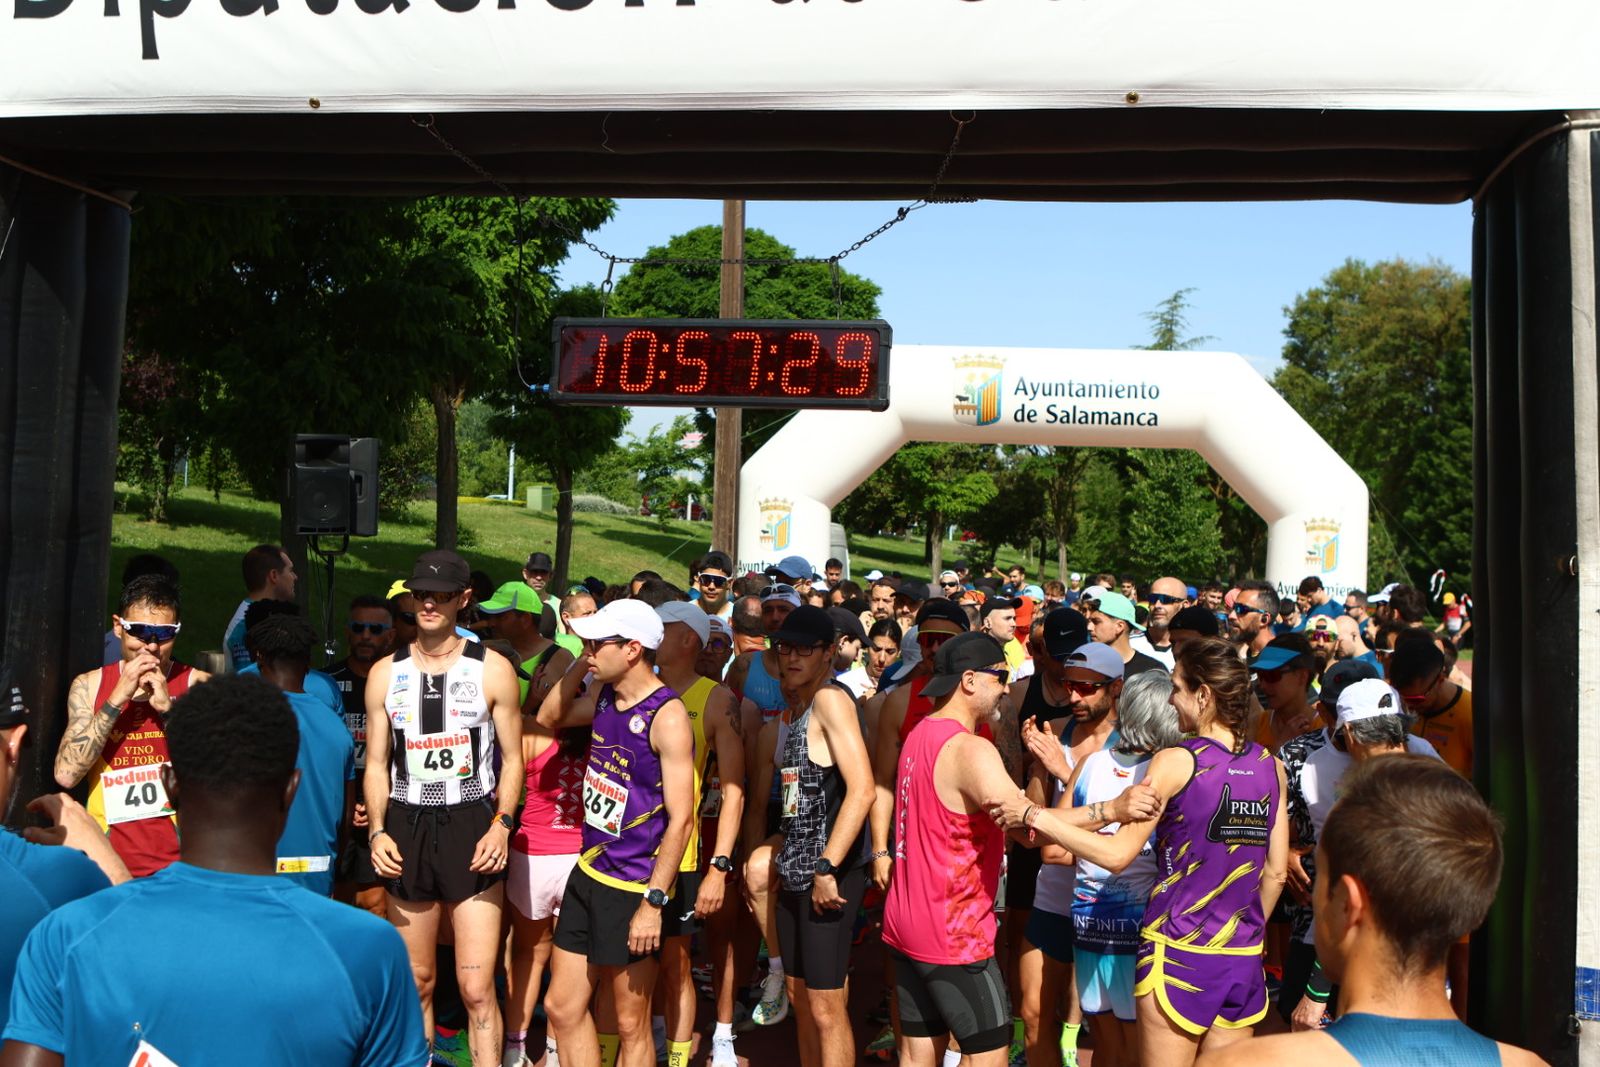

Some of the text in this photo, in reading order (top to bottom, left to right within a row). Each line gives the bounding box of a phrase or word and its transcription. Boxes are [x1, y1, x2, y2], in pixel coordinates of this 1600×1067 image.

[595, 330, 872, 396] 10:57:29
[1014, 376, 1160, 401] Ayuntamiento
[1014, 403, 1158, 427] de Salamanca
[124, 745, 154, 756] VINO
[406, 733, 469, 751] bedunia
[114, 755, 165, 767] DE TORO
[424, 748, 454, 771] 48
[103, 766, 162, 789] beduni
[585, 770, 626, 804] bedunia
[125, 782, 157, 807] 40
[584, 786, 617, 820] 267
[1230, 801, 1270, 816] PRIM
[1074, 913, 1143, 934] INFINITY
